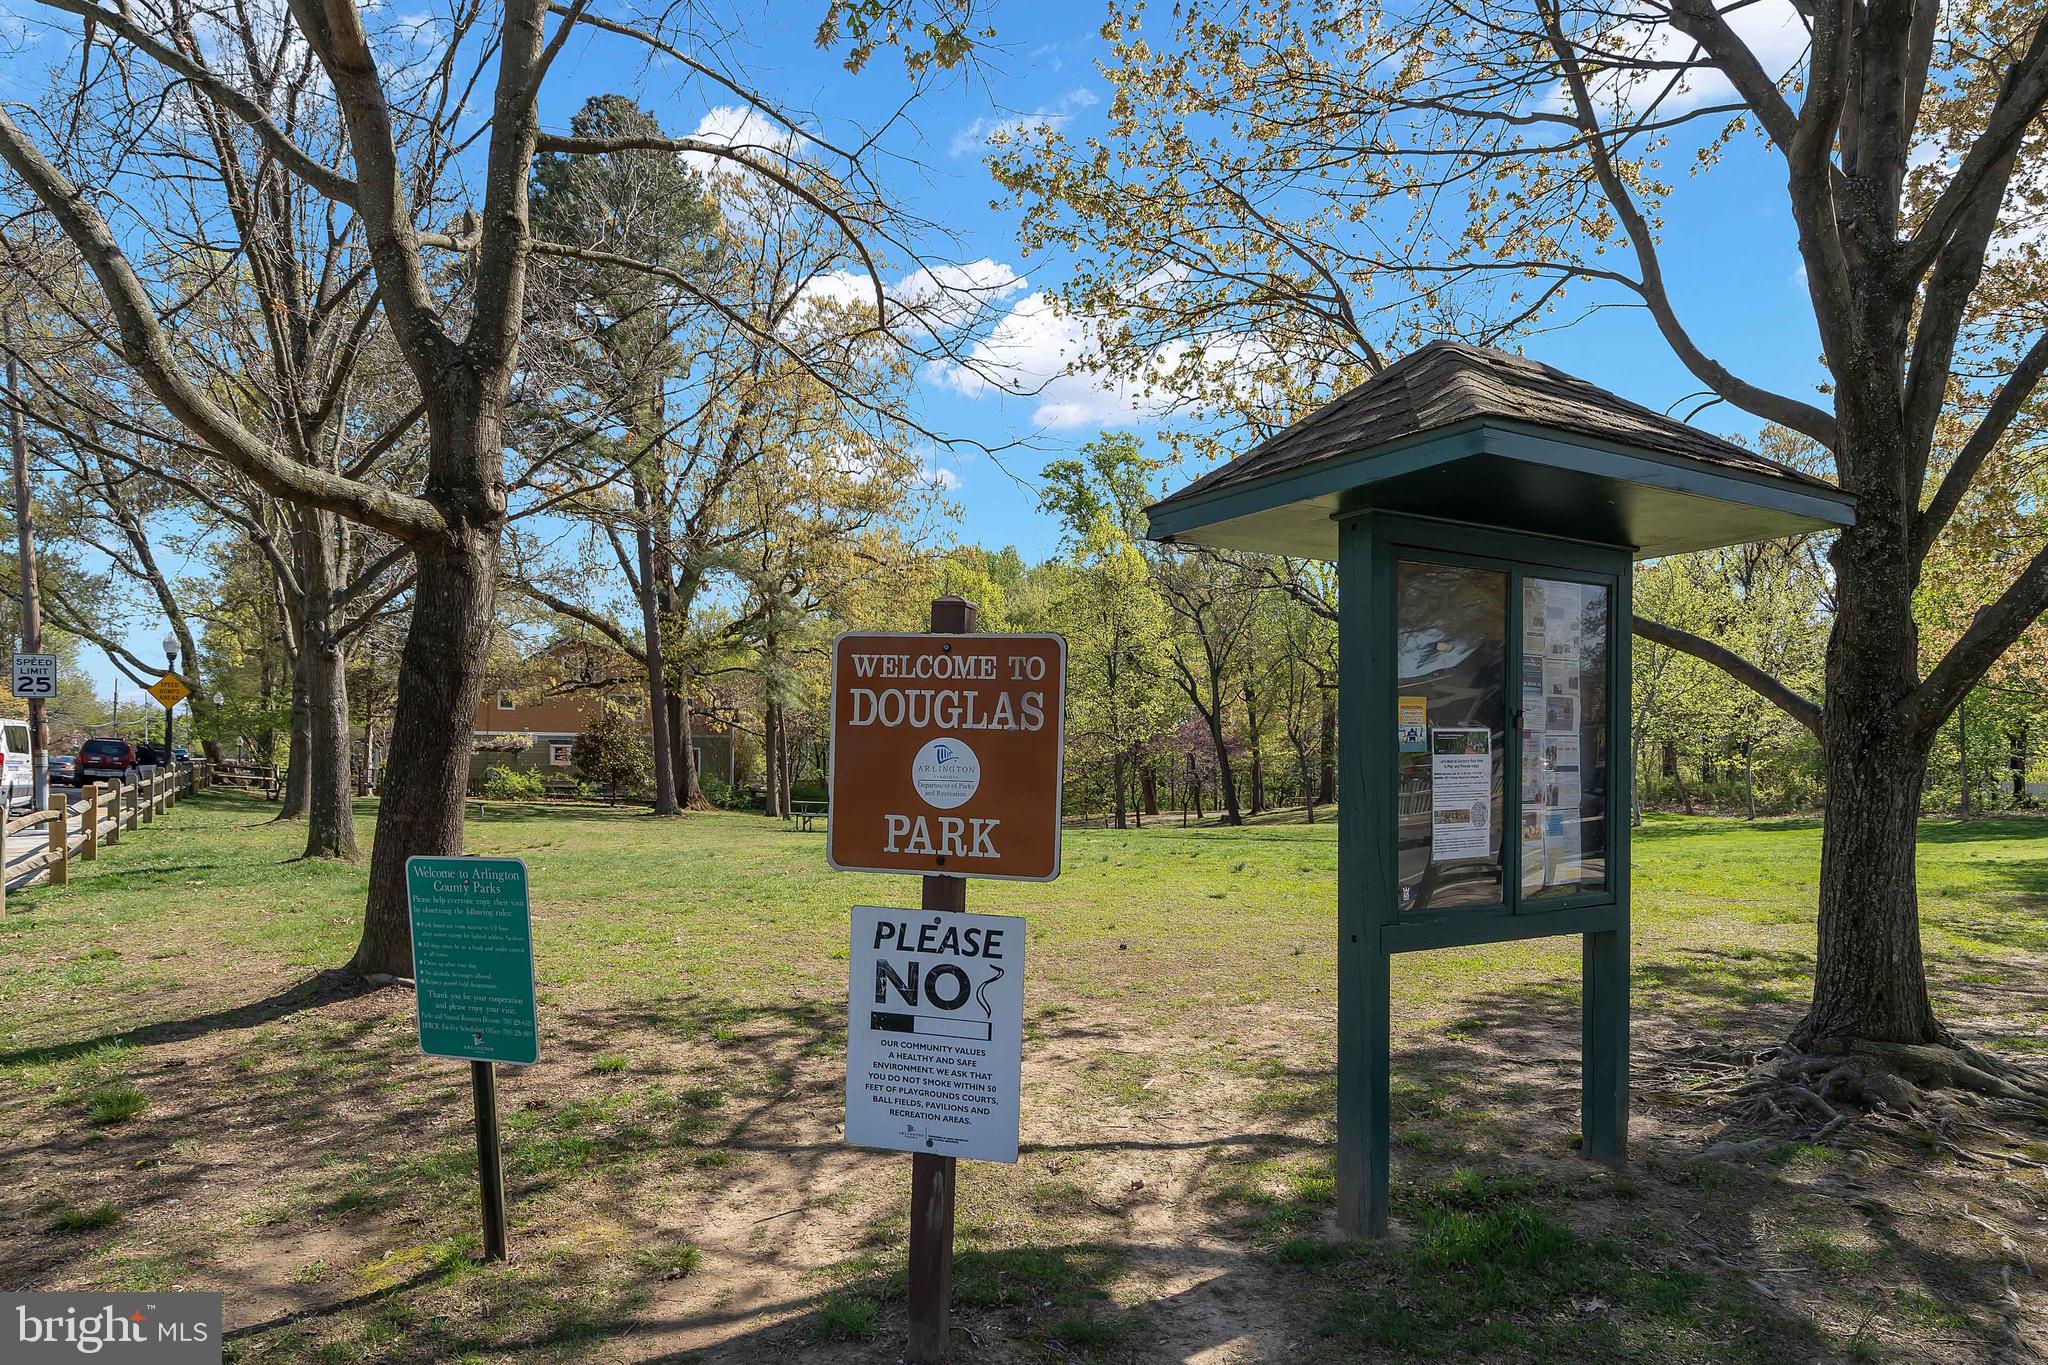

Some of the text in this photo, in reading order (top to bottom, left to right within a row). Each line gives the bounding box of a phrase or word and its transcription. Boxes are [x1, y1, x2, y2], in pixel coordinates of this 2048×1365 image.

[852, 654, 1046, 681] WELCOME TO
[18, 676, 51, 692] 25
[849, 688, 1044, 731] DOUGLAS
[918, 781, 951, 789] Department
[884, 814, 1000, 858] PARK
[413, 866, 520, 883] Welcome to Arlington
[434, 880, 501, 896] County Parks
[412, 895, 431, 903] Please
[433, 896, 445, 905] help
[476, 899, 490, 907] enjoy
[423, 907, 452, 915] observing
[466, 908, 493, 917] following
[874, 921, 1003, 959] PLEASE
[875, 959, 971, 1010] NO
[427, 990, 448, 998] Thank
[489, 995, 523, 1005] cooperation
[449, 1003, 466, 1011] please
[468, 1005, 483, 1013] enjoy
[881, 1039, 986, 1056] OUR COMMUNITY VALUES
[897, 1053, 934, 1062] HEALTHY
[936, 1057, 954, 1065] AND
[957, 1059, 977, 1067] SAFE
[873, 1061, 992, 1080] ENVIRONMENT. WE ASK THAT
[868, 1072, 997, 1093] YOU DO NOT SMOKE WITHIN 50
[865, 1083, 884, 1092] FEET
[899, 1087, 960, 1100] PLAYGROUNDS
[962, 1094, 999, 1105] COURTS,
[873, 1095, 990, 1115] BALL FIELDS, PAVILIONS AND
[890, 1108, 972, 1125] RECREATION AREAS.
